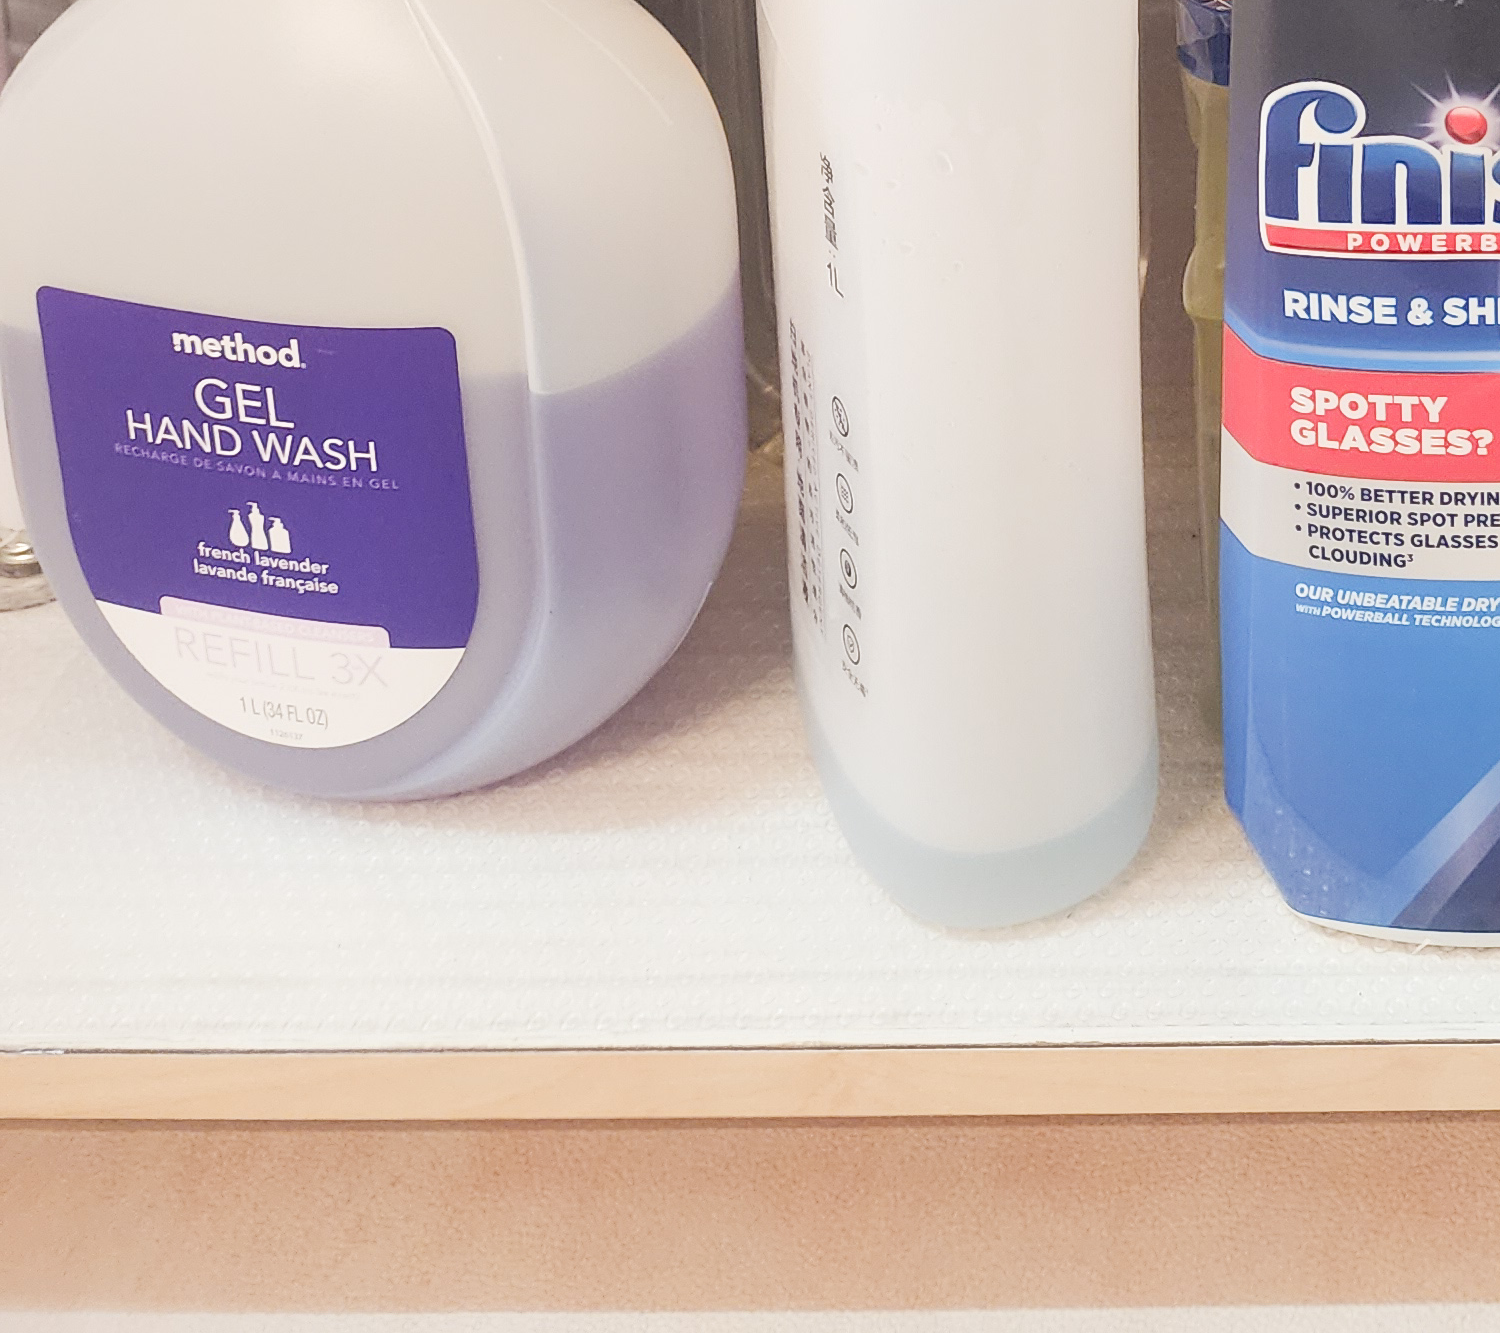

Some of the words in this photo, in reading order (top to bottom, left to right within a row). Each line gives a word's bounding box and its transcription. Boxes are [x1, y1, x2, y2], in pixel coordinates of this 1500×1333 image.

[1283, 288, 1399, 326] RINSE
[1406, 294, 1435, 327] &
[194, 377, 295, 430] GEL
[1289, 386, 1449, 424] SPOTTY
[126, 408, 243, 458] HAND
[252, 429, 379, 473] WASH
[1290, 419, 1495, 457] GLASSES?
[114, 442, 188, 468] RECHARGE
[193, 457, 214, 472] DE
[216, 460, 267, 481] SAVON
[286, 471, 338, 488] MAINS
[342, 475, 364, 490] EN
[369, 477, 400, 491] GEL
[1306, 480, 1356, 502] 100%
[1360, 487, 1435, 507] BETTER
[1307, 501, 1403, 527] SUPERIOR
[1407, 509, 1459, 528] SPOT
[1308, 523, 1405, 549] PROTECTS
[1410, 531, 1500, 550] GLASSES
[193, 558, 259, 584] lavande
[261, 570, 340, 596] française
[198, 541, 252, 565] french
[254, 550, 330, 576] lavender
[1295, 582, 1335, 605] OUR
[1337, 588, 1459, 613] UNBEATABLE
[1296, 602, 1321, 617] WITH
[1321, 605, 1411, 627] POWERBALL
[174, 625, 315, 681] REFILL
[252, 698, 262, 716] L
[287, 704, 304, 724] FL
[307, 707, 330, 730] OZ)
